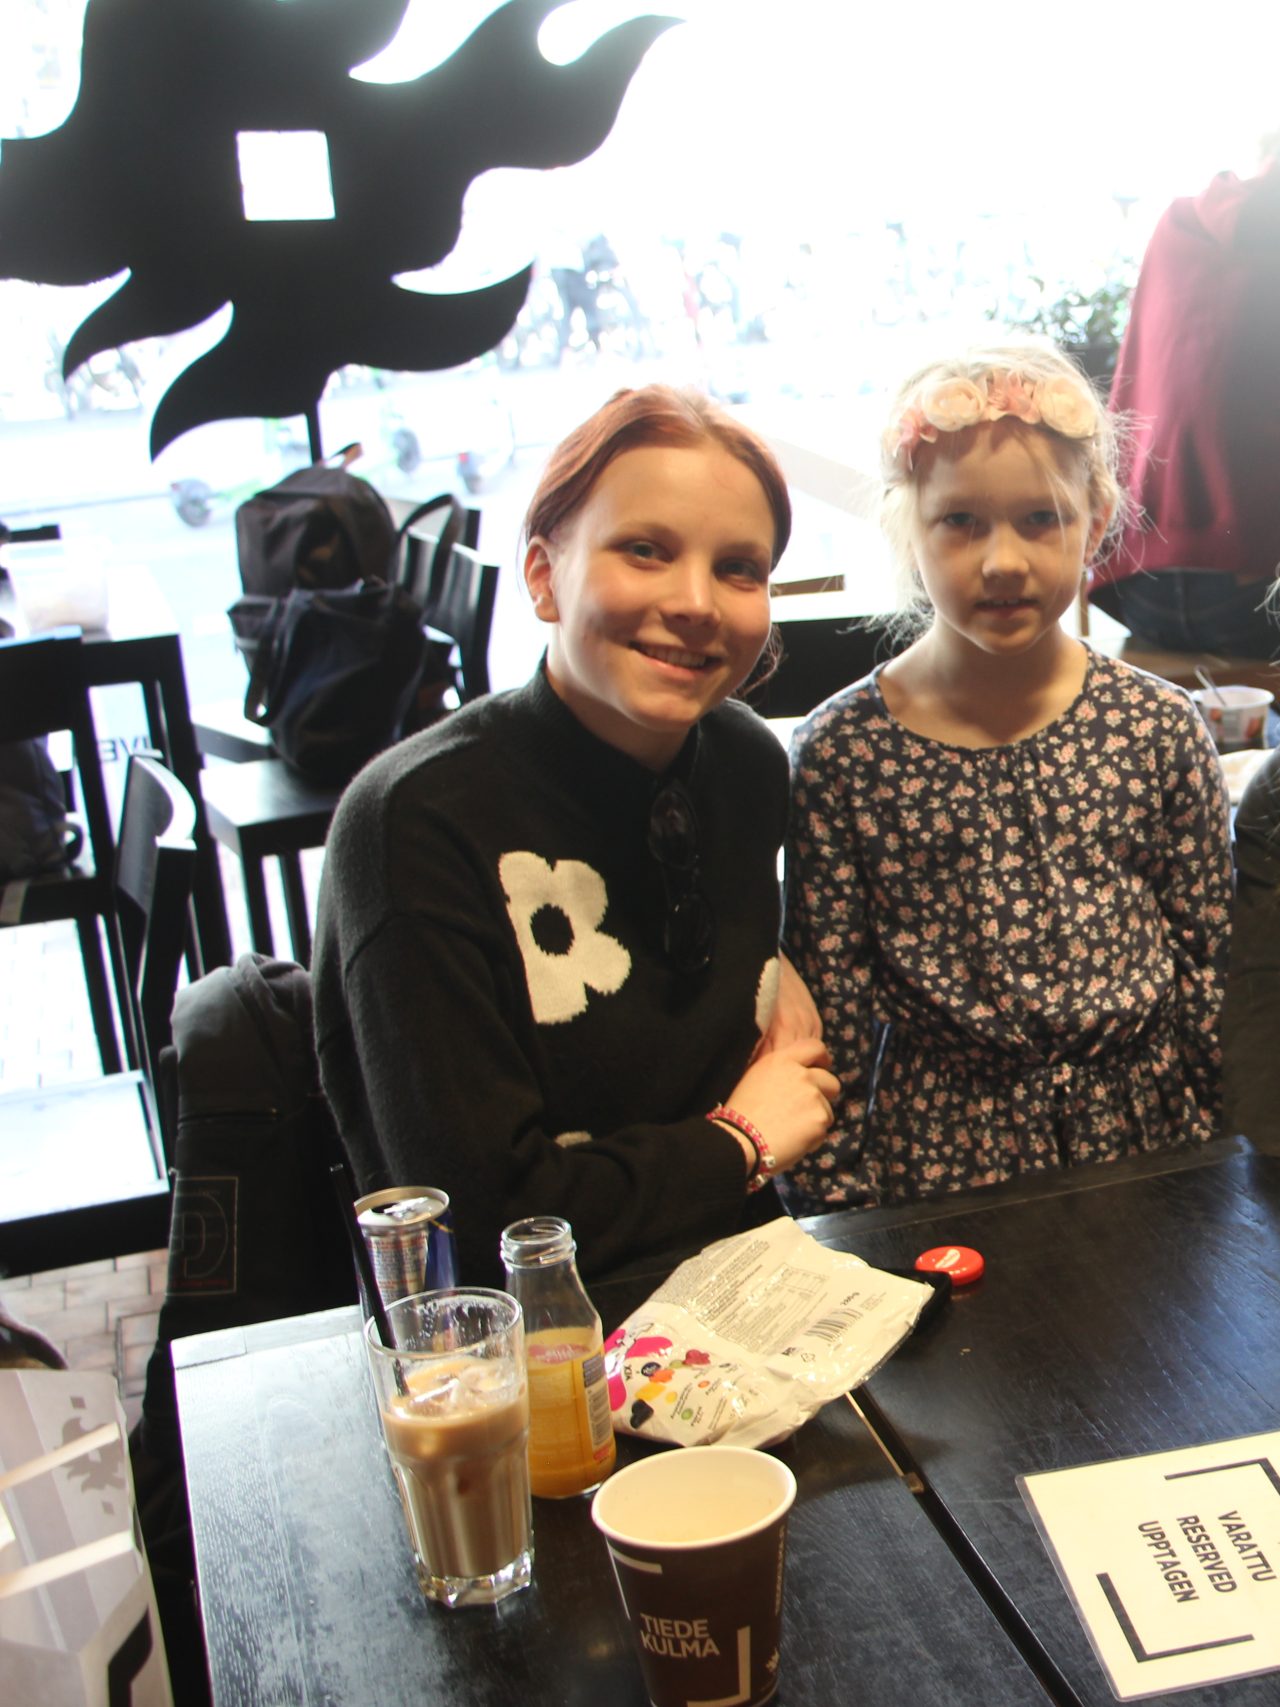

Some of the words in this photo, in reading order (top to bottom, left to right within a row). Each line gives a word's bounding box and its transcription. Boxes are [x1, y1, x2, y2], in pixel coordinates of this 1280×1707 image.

[1138, 1521, 1200, 1603] UPPTAGEN
[1177, 1514, 1237, 1593] RESERVED
[1218, 1510, 1278, 1582] VARATTU
[640, 1613, 710, 1639] TIEDE
[640, 1630, 720, 1658] KULMA
